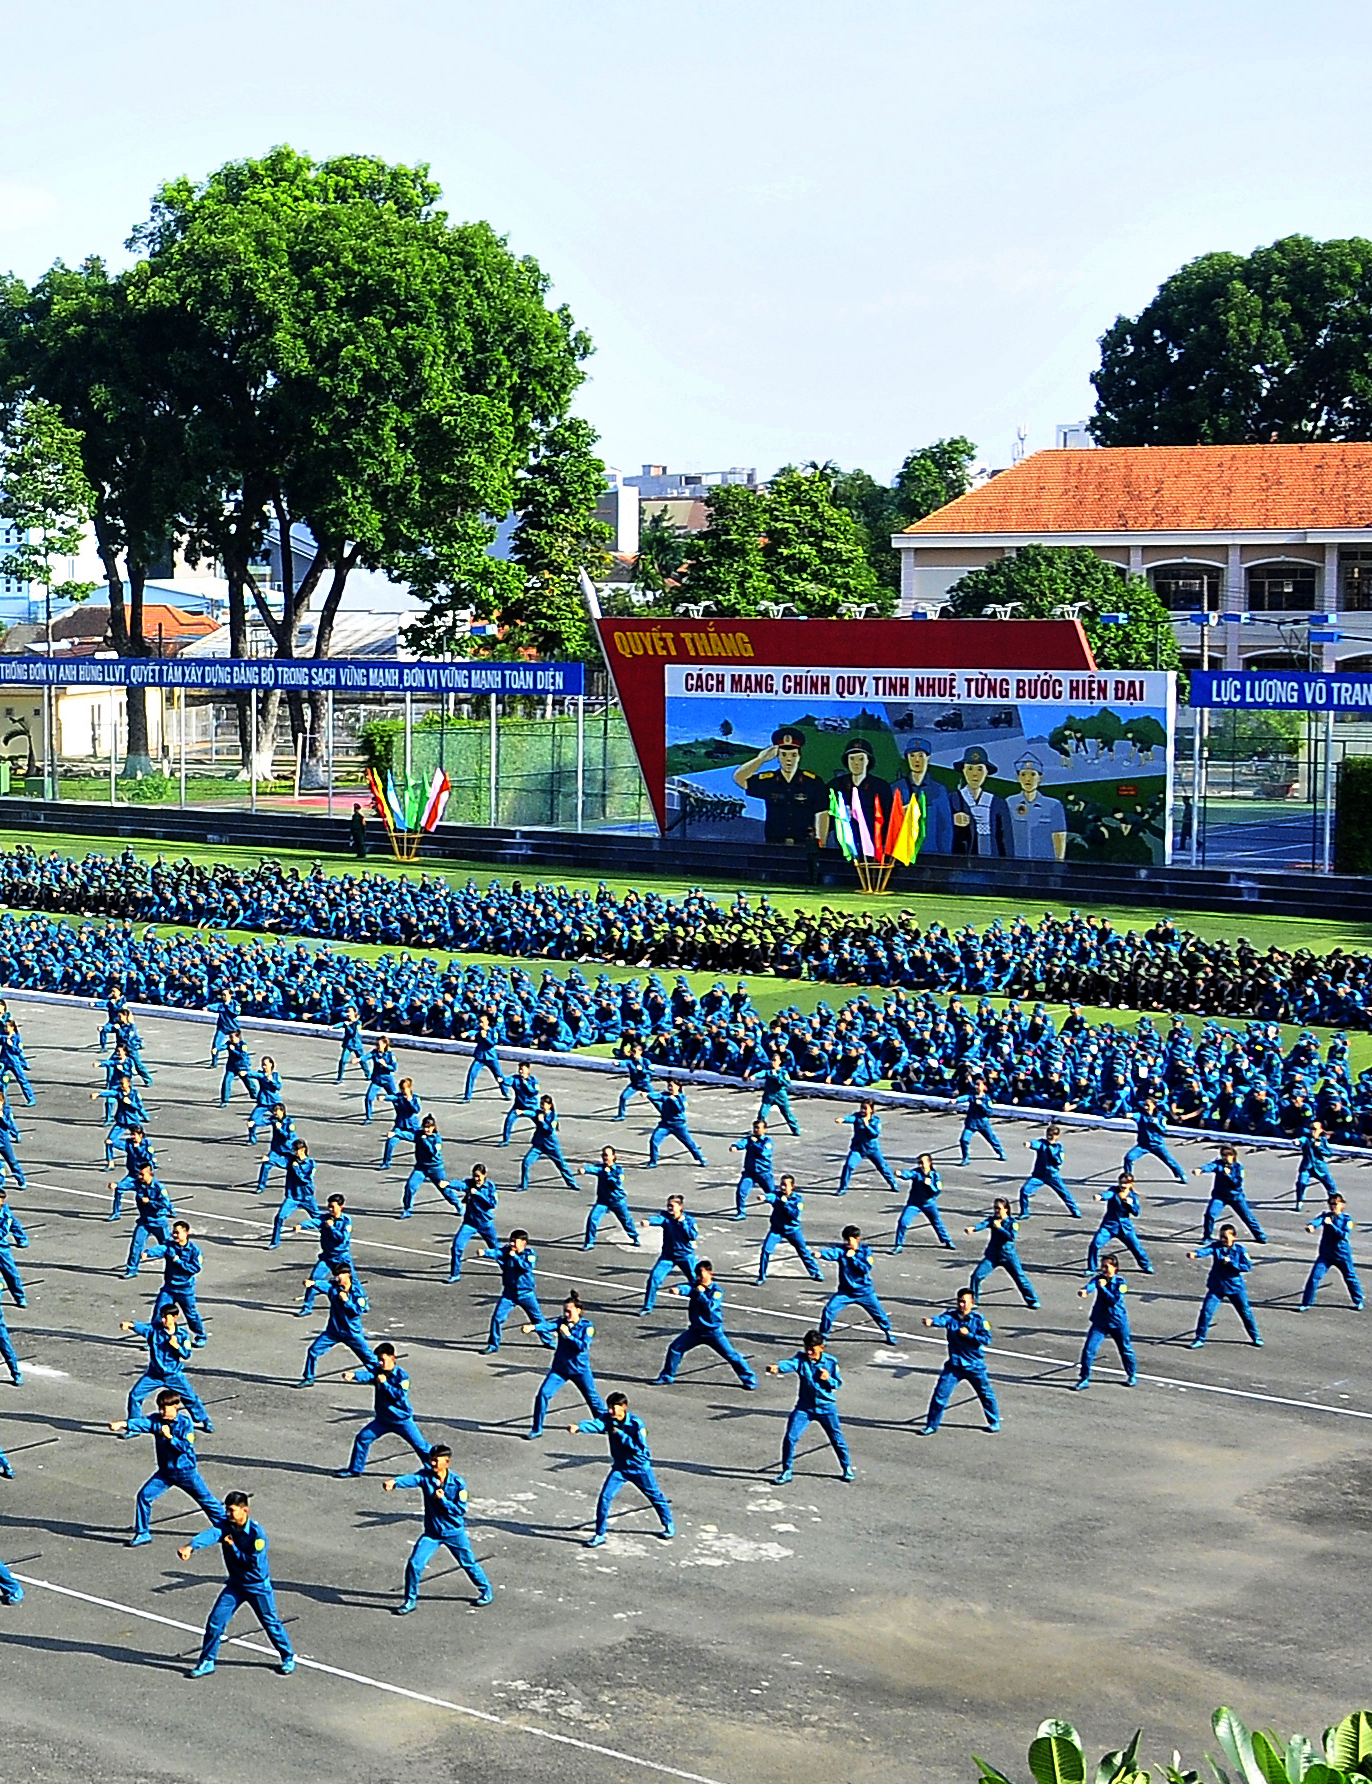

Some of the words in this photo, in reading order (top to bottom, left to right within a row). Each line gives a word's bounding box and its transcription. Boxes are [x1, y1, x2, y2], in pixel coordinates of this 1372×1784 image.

[613, 625, 677, 658] QUYẾT
[680, 621, 755, 657] THẮNG
[0, 660, 28, 680] THỐNG
[29, 661, 47, 681] ĐƠN
[48, 663, 58, 684] VỊ
[58, 664, 77, 681] ANH
[79, 661, 103, 682] HÙNG
[104, 664, 129, 685] LLVT,
[130, 661, 161, 684] QUYẾT
[162, 662, 183, 683] TÂM
[184, 662, 203, 684] XÂY
[204, 663, 232, 687] DỰNG
[233, 662, 259, 684] ĐẢNG
[261, 663, 275, 687] BỘ
[276, 666, 309, 685] TRONG
[311, 667, 336, 687] SẠCH
[339, 665, 368, 686] VỮNG
[369, 668, 403, 690] MẠNH,
[403, 666, 425, 688] ĐƠN
[426, 669, 438, 690] VỊ
[439, 666, 469, 688] VỮNG
[471, 669, 502, 691] MẠNH
[503, 666, 534, 689] TOÀN
[536, 667, 564, 692] DIỆN
[684, 667, 725, 693] CÁCH
[730, 673, 779, 698] MẠNG,
[782, 669, 830, 695] CHÍNH
[835, 675, 869, 699] QUY,
[872, 676, 910, 697] TINH
[914, 672, 961, 702] NHUỆ,
[964, 671, 1010, 699] TỪNG
[1015, 671, 1063, 700] BƯỚC
[1068, 674, 1108, 705] HIỆN
[1113, 679, 1145, 706] ĐẠI
[1212, 677, 1241, 706] LỰC
[1245, 678, 1299, 706] LƯỢNG
[1303, 678, 1327, 705] VÕ
